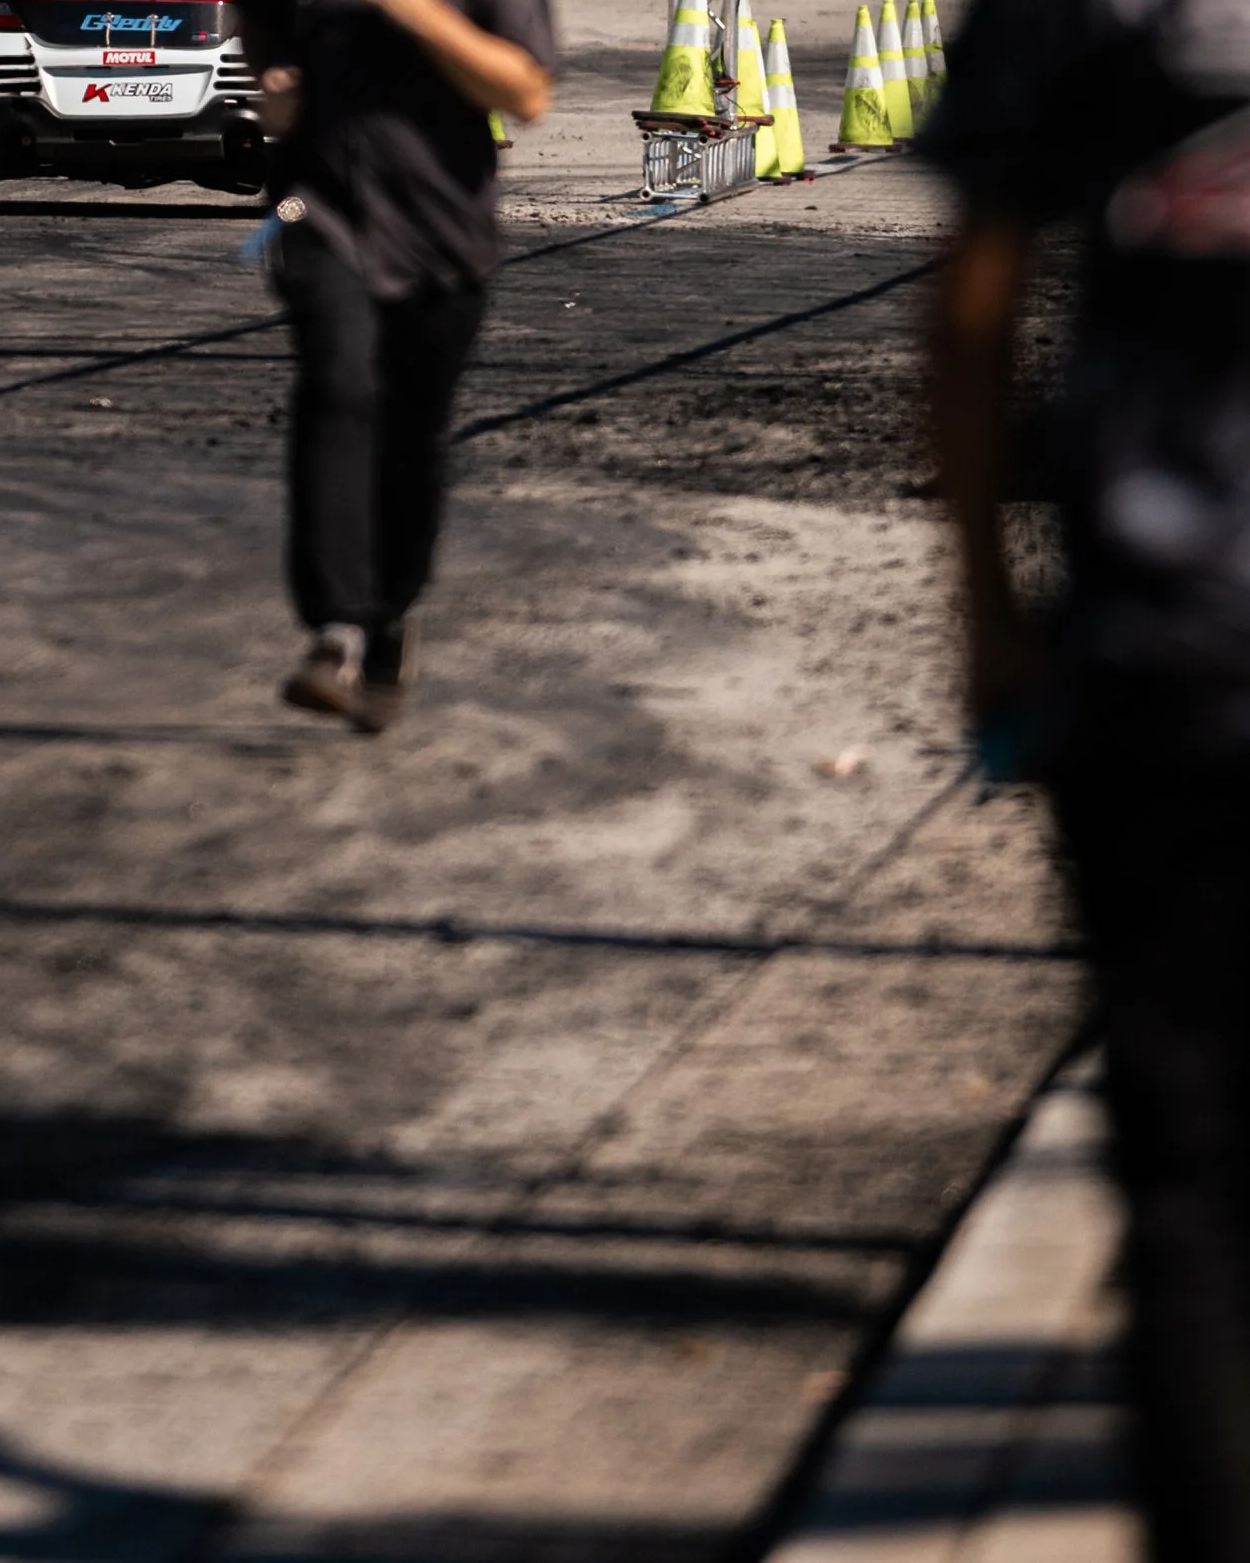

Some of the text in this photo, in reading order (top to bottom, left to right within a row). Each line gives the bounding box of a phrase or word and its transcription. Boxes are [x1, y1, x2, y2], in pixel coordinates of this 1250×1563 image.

[106, 52, 153, 63] MOTUL
[110, 82, 173, 97] KENDA
[149, 95, 173, 103] TIRES
